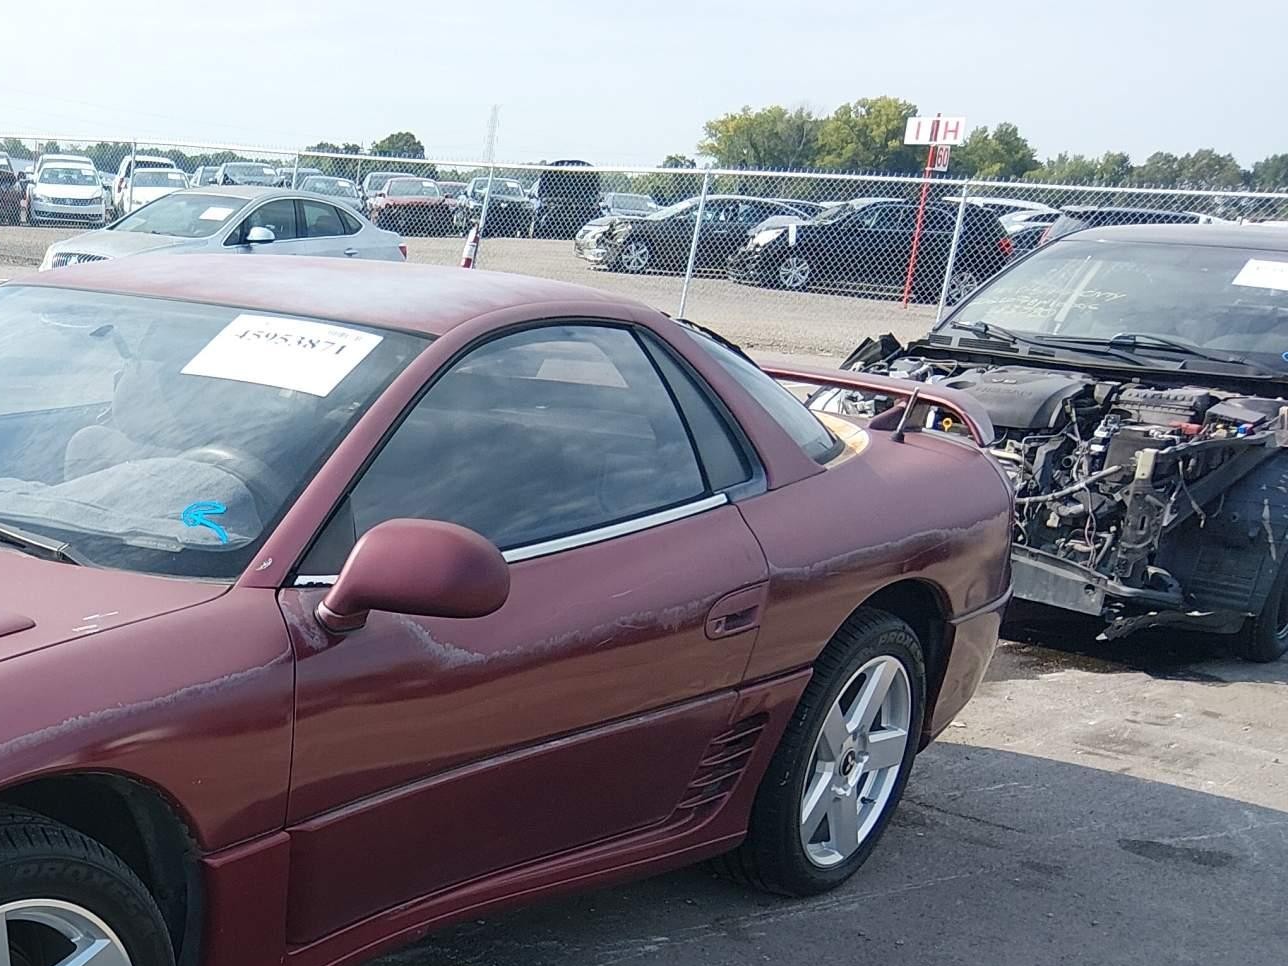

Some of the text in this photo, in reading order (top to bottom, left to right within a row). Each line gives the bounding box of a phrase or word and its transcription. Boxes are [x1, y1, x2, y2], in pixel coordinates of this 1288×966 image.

[942, 120, 960, 141] H
[936, 147, 950, 168] 60
[235, 328, 348, 356] 45953871
